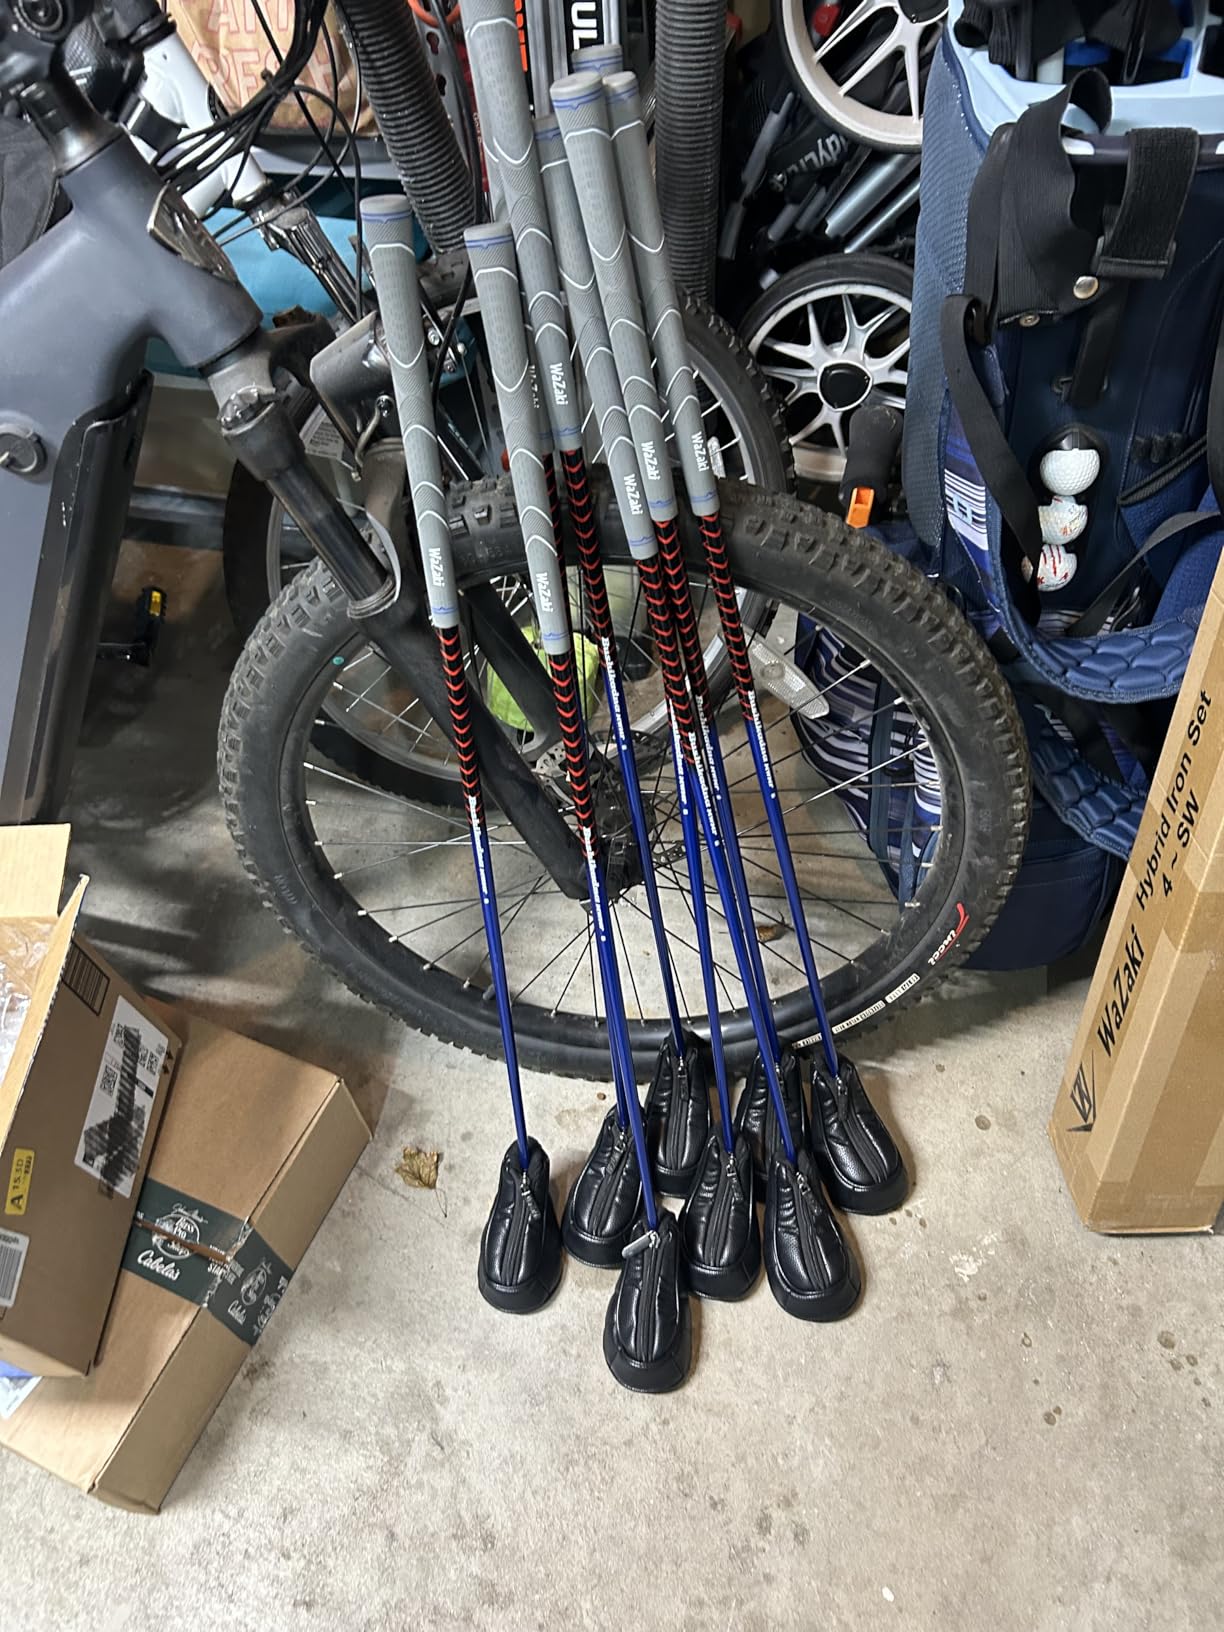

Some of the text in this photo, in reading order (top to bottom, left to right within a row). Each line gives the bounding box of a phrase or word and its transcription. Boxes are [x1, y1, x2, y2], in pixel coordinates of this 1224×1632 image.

[550, 362, 569, 406] WaZaki
[641, 441, 660, 481] WaZaki
[690, 431, 709, 473] WaZaki
[623, 473, 643, 516] WaZaki
[429, 547, 445, 588] WaZaki
[536, 571, 555, 613] WaZaki
[1162, 880, 1173, 898] 4
[1177, 788, 1201, 850] SW
[1096, 689, 1212, 1059] WaZaki Hybrid Iron Set
[11, 1195, 24, 1210] A
